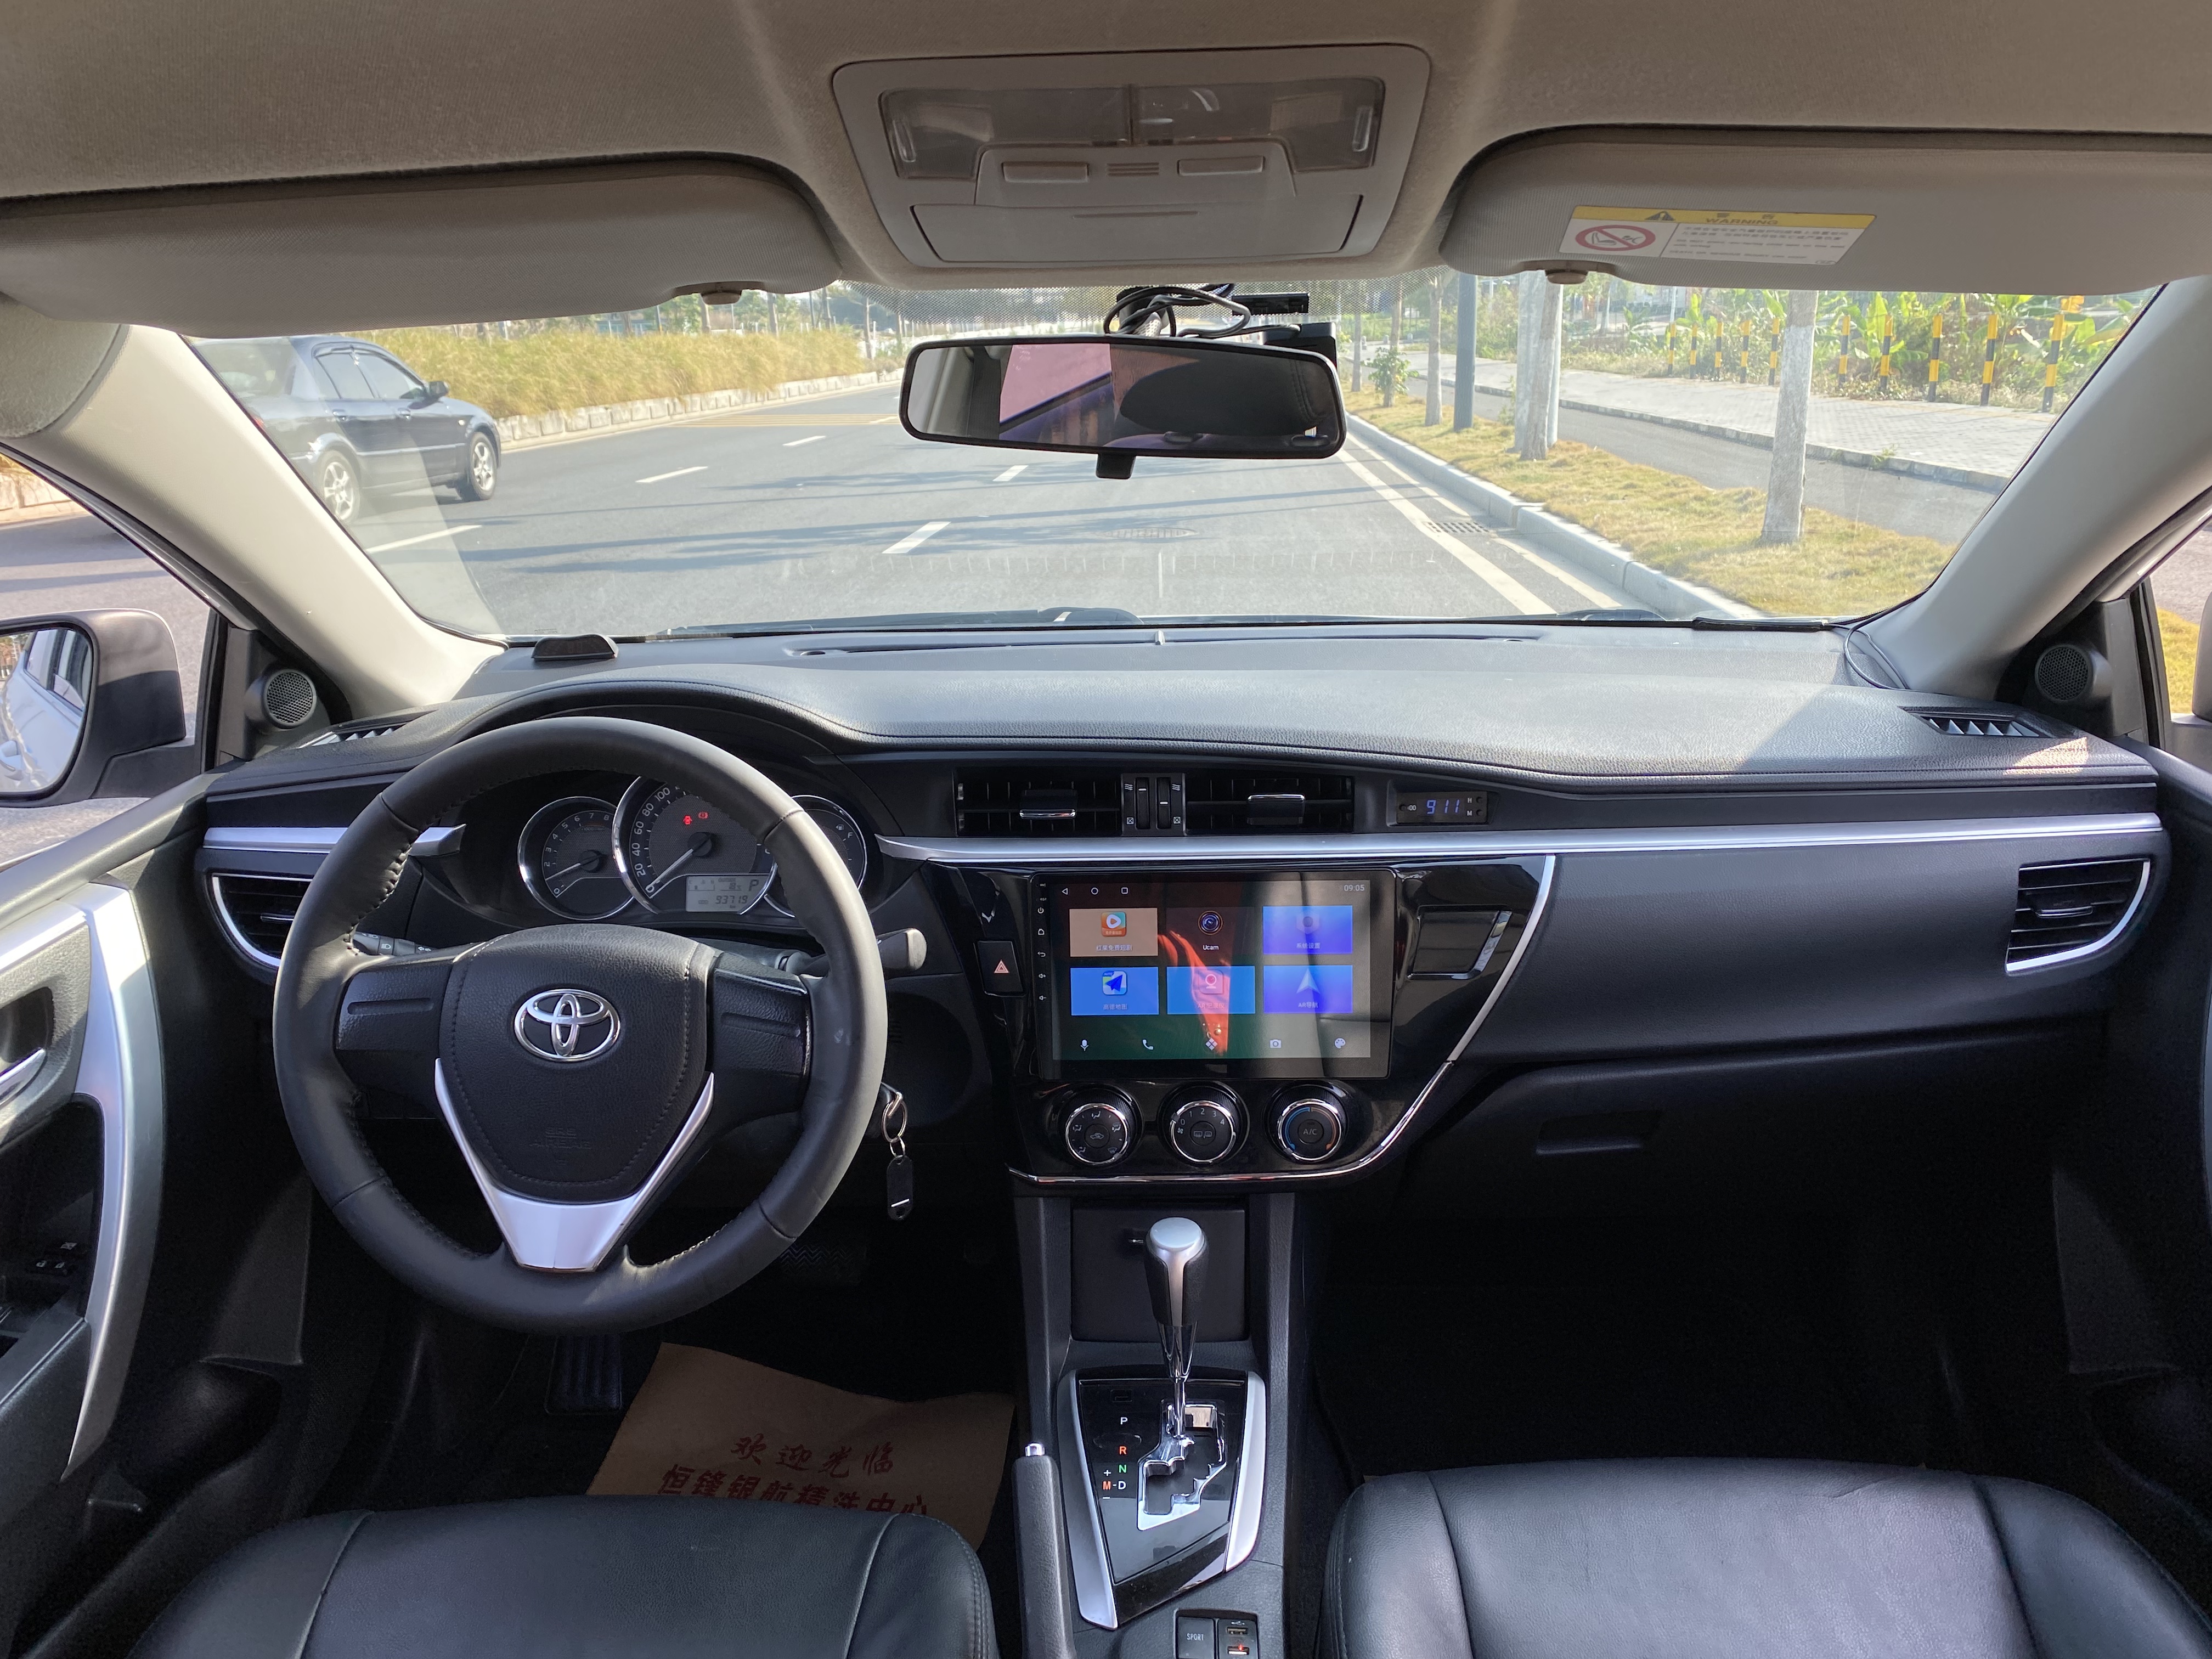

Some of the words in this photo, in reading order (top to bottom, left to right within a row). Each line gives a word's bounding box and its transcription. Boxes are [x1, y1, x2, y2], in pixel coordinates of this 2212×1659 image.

[654, 787, 670, 802] 100
[642, 803, 654, 816] 80
[634, 821, 644, 834] 60
[631, 843, 640, 856] 40
[634, 863, 646, 877] 20
[645, 885, 655, 893] 0
[748, 879, 759, 891] P
[715, 895, 748, 904] 93719
[731, 1433, 894, 1478] 欢迎光临
[1119, 1446, 1127, 1455] R
[1119, 1464, 1127, 1473] N
[1186, 1633, 1204, 1641] SPORT
